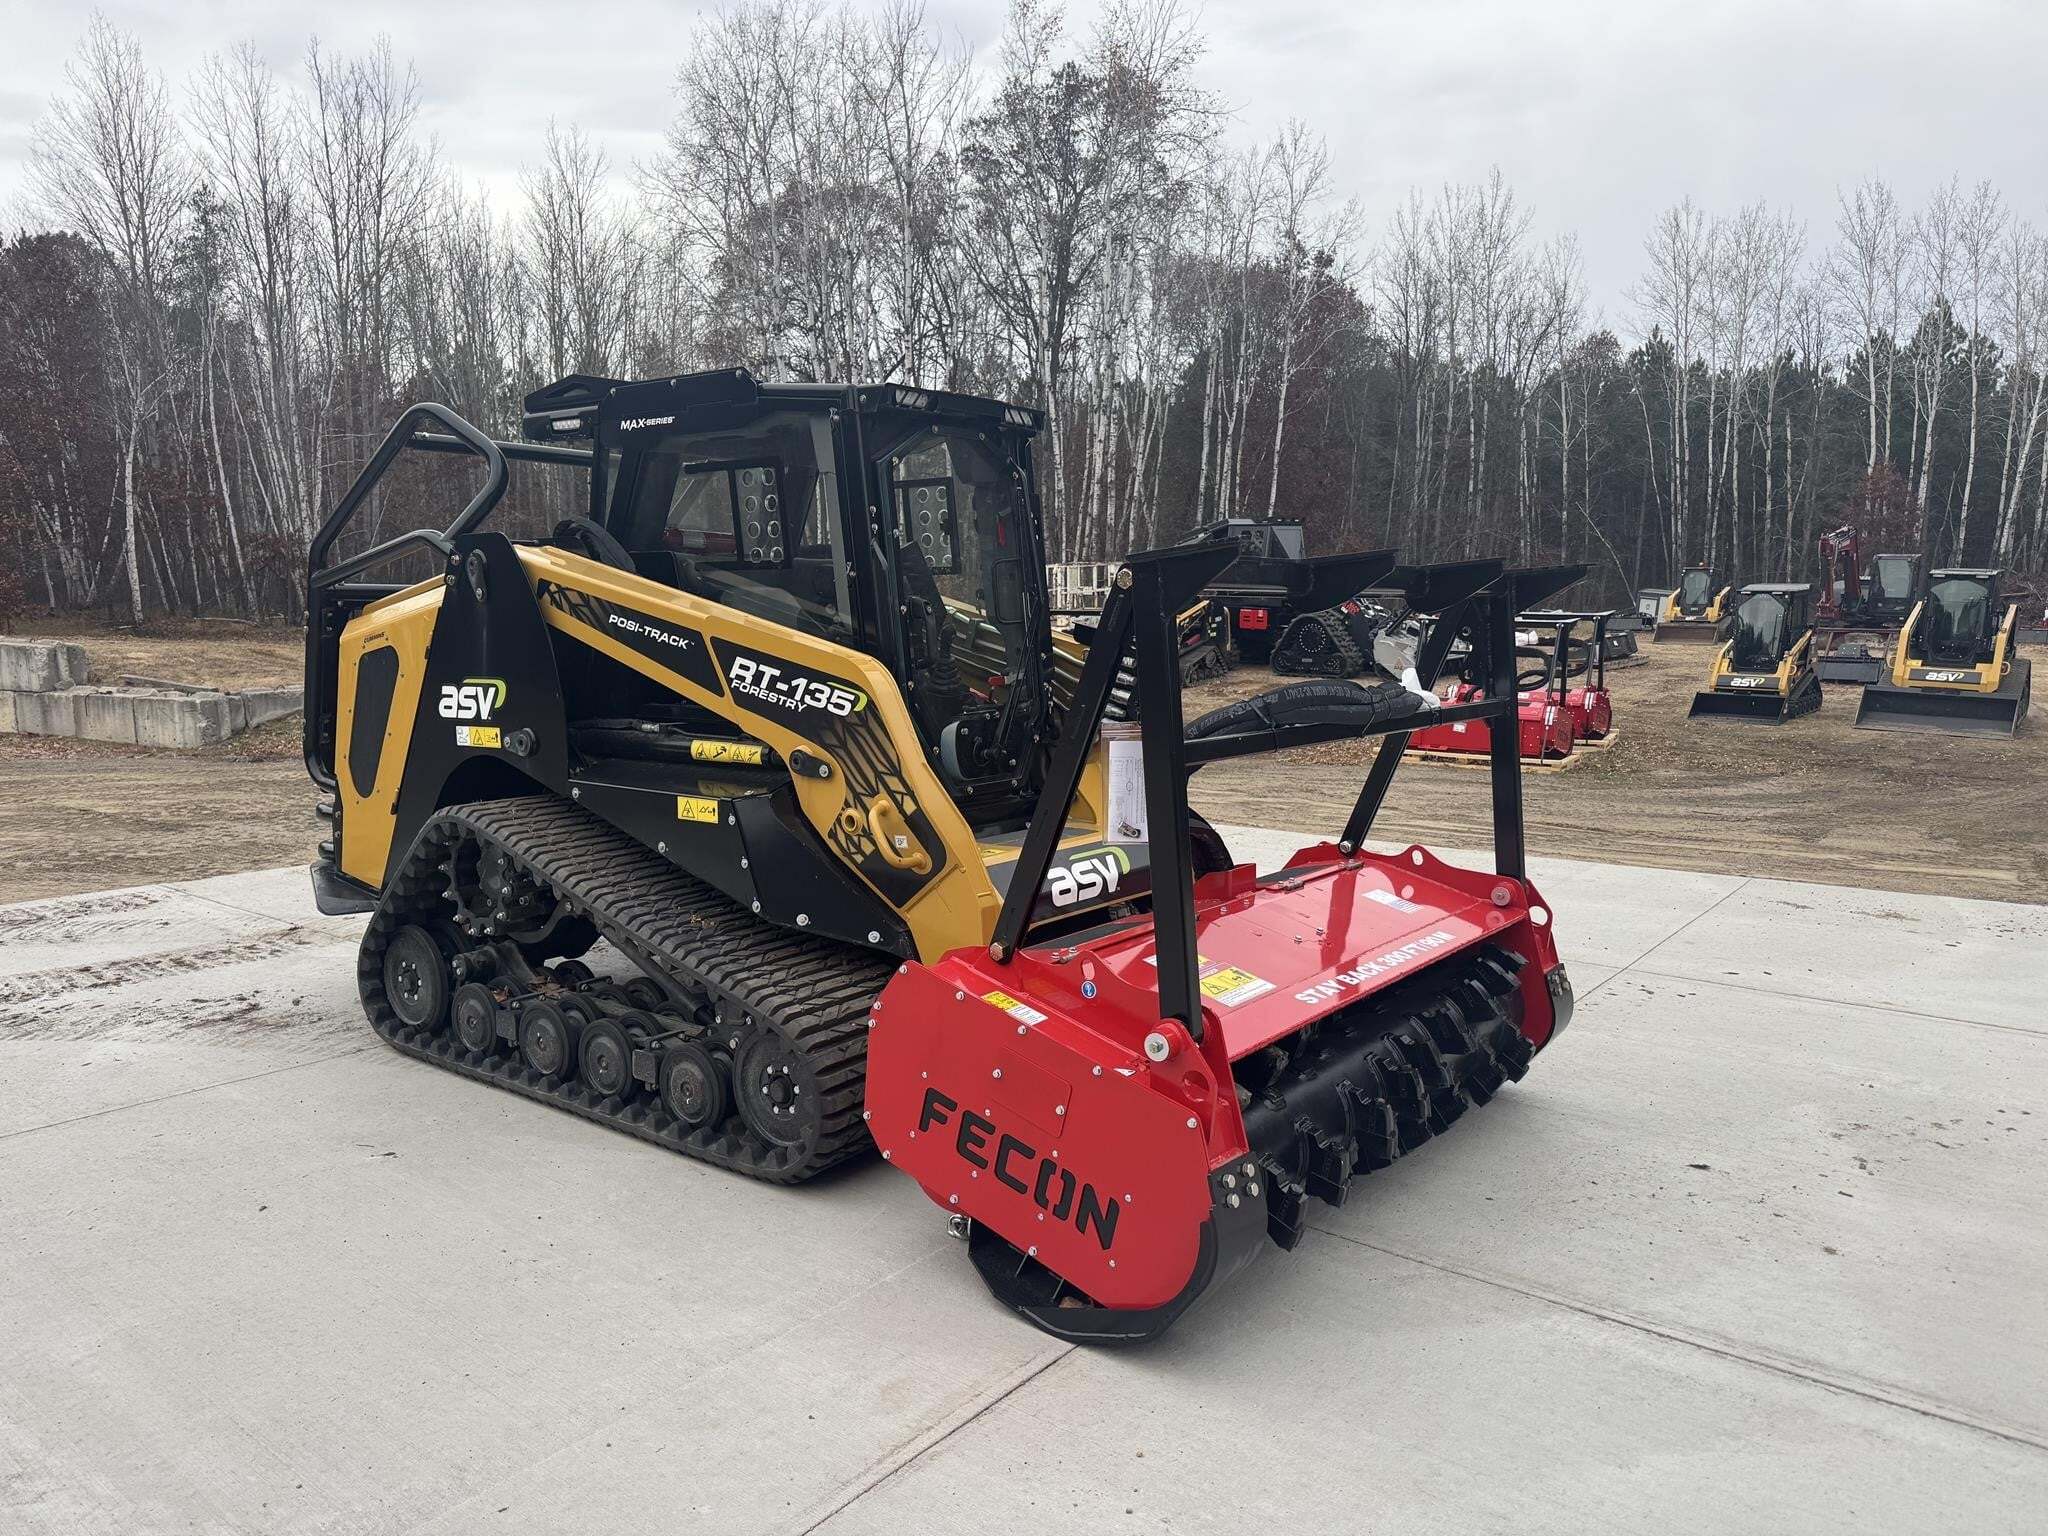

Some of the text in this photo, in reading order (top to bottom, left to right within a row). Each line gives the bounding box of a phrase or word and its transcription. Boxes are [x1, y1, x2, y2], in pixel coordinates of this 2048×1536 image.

[608, 614, 690, 650] POSI-TRACK
[729, 656, 856, 717] RT-135
[731, 679, 808, 713] FORESTRY
[1294, 979, 1347, 1004] STAY
[1335, 961, 1391, 986] BACK
[918, 1087, 1120, 1251] FECON
